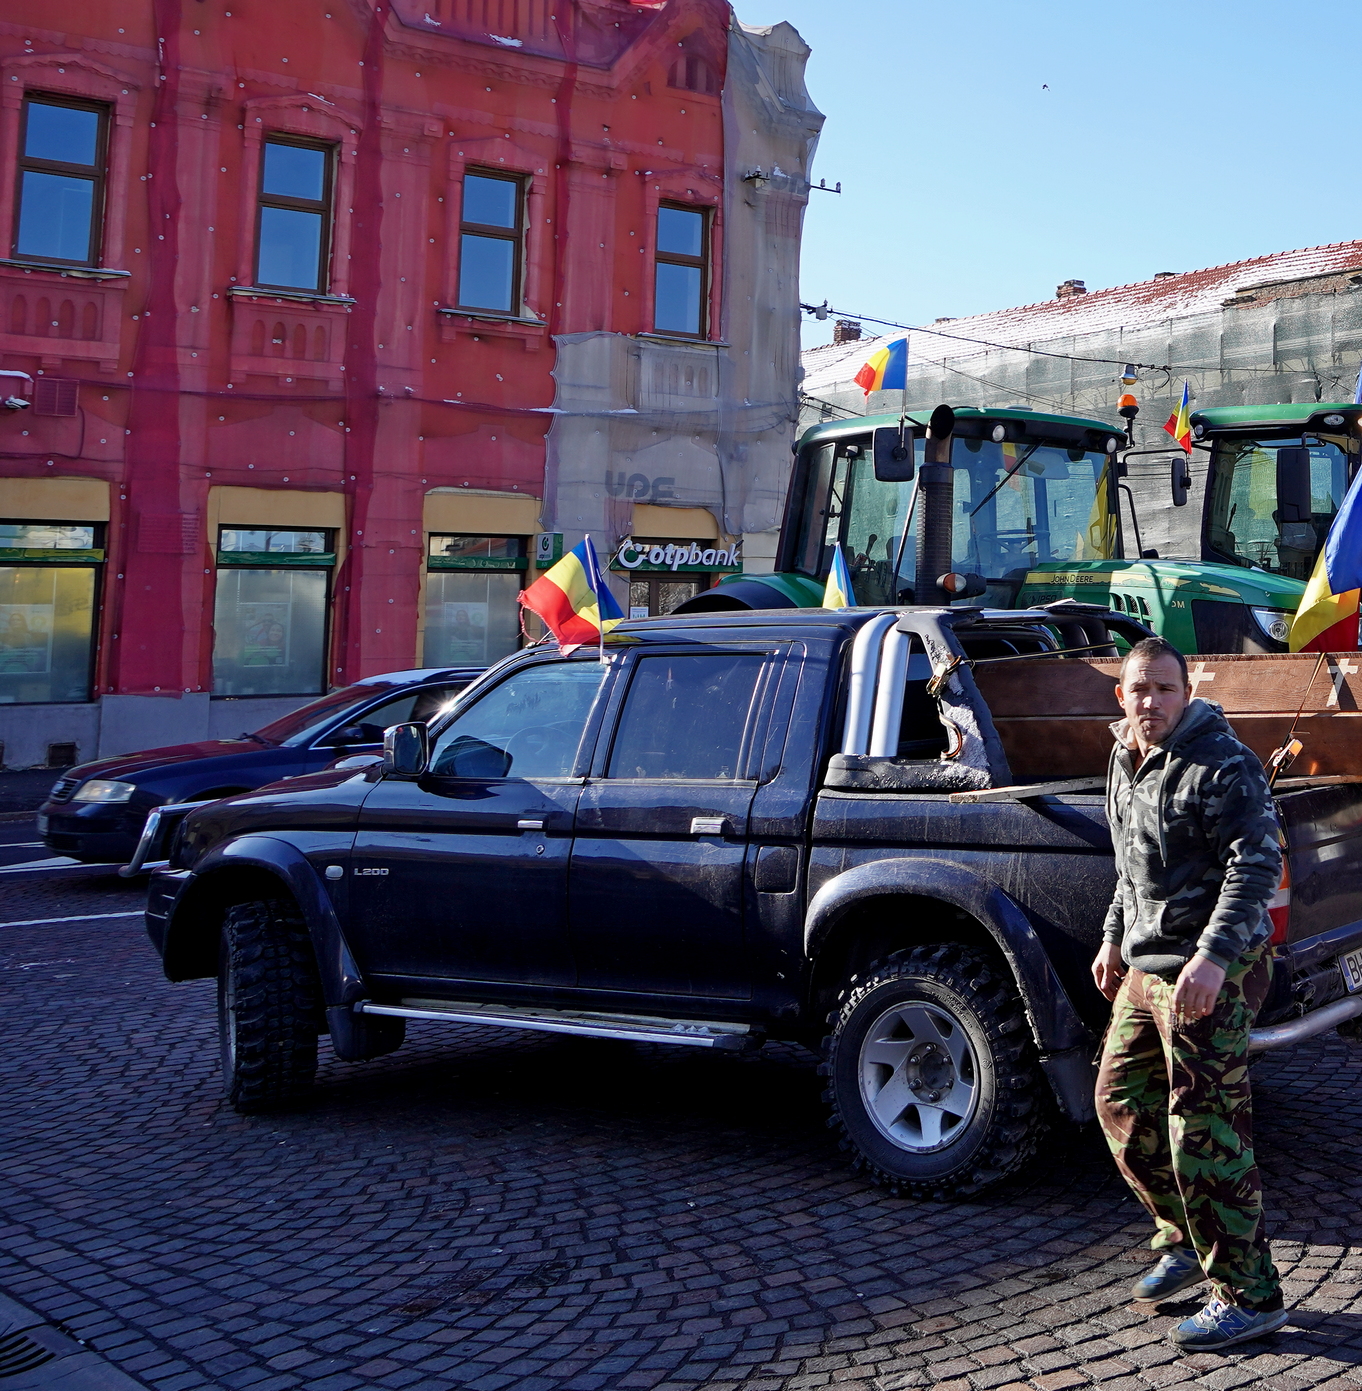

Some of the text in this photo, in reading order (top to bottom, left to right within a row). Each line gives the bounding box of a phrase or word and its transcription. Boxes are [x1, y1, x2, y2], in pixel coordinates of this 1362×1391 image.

[649, 542, 741, 571] otpbank
[1050, 574, 1094, 584] JOHN DEERE
[354, 868, 389, 876] L200
